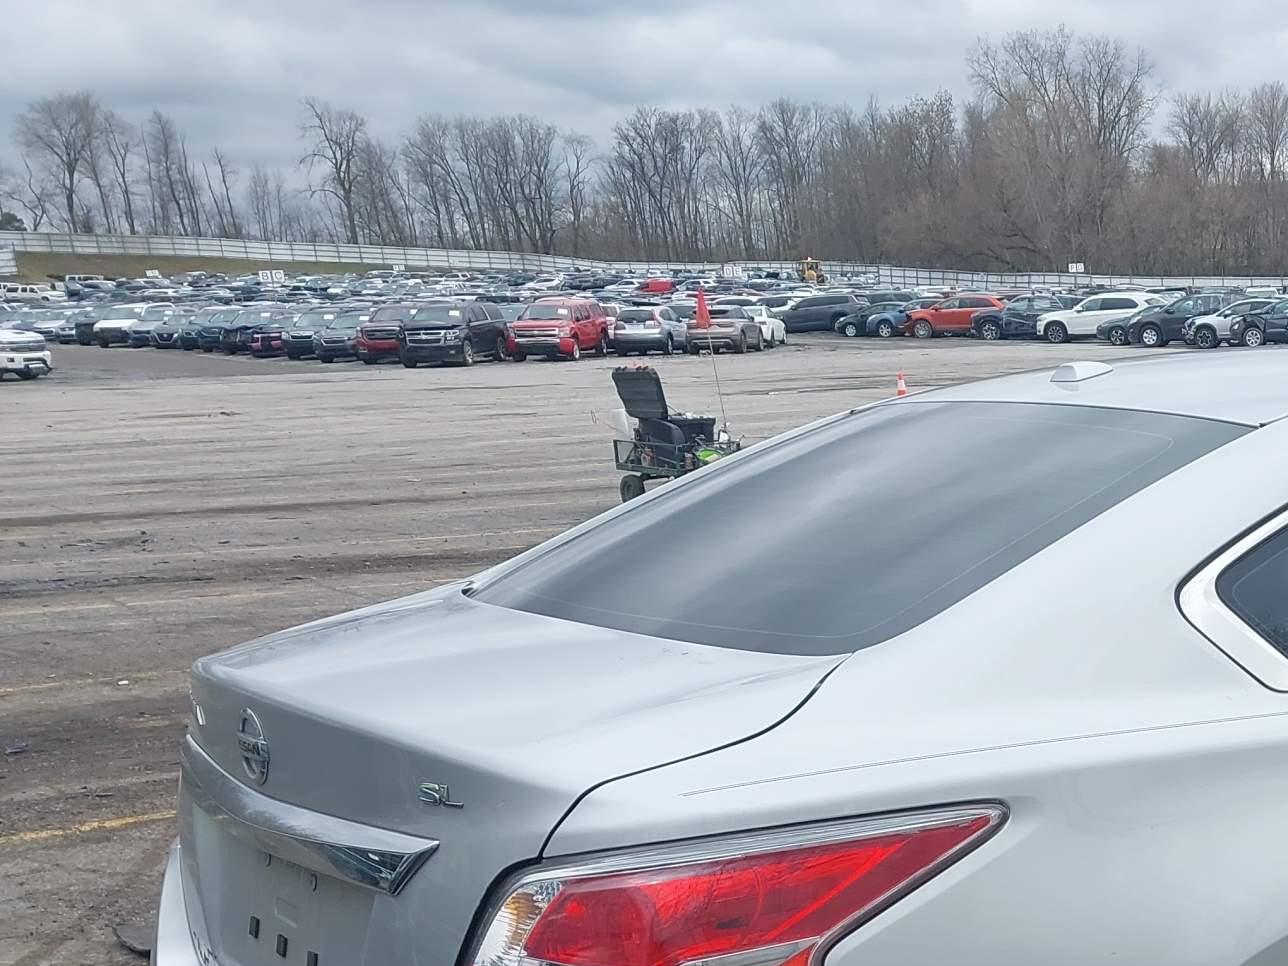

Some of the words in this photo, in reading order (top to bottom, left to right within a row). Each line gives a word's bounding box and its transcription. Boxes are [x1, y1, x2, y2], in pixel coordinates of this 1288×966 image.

[261, 271, 270, 281] B
[274, 271, 283, 281] C
[416, 782, 465, 809] SL
